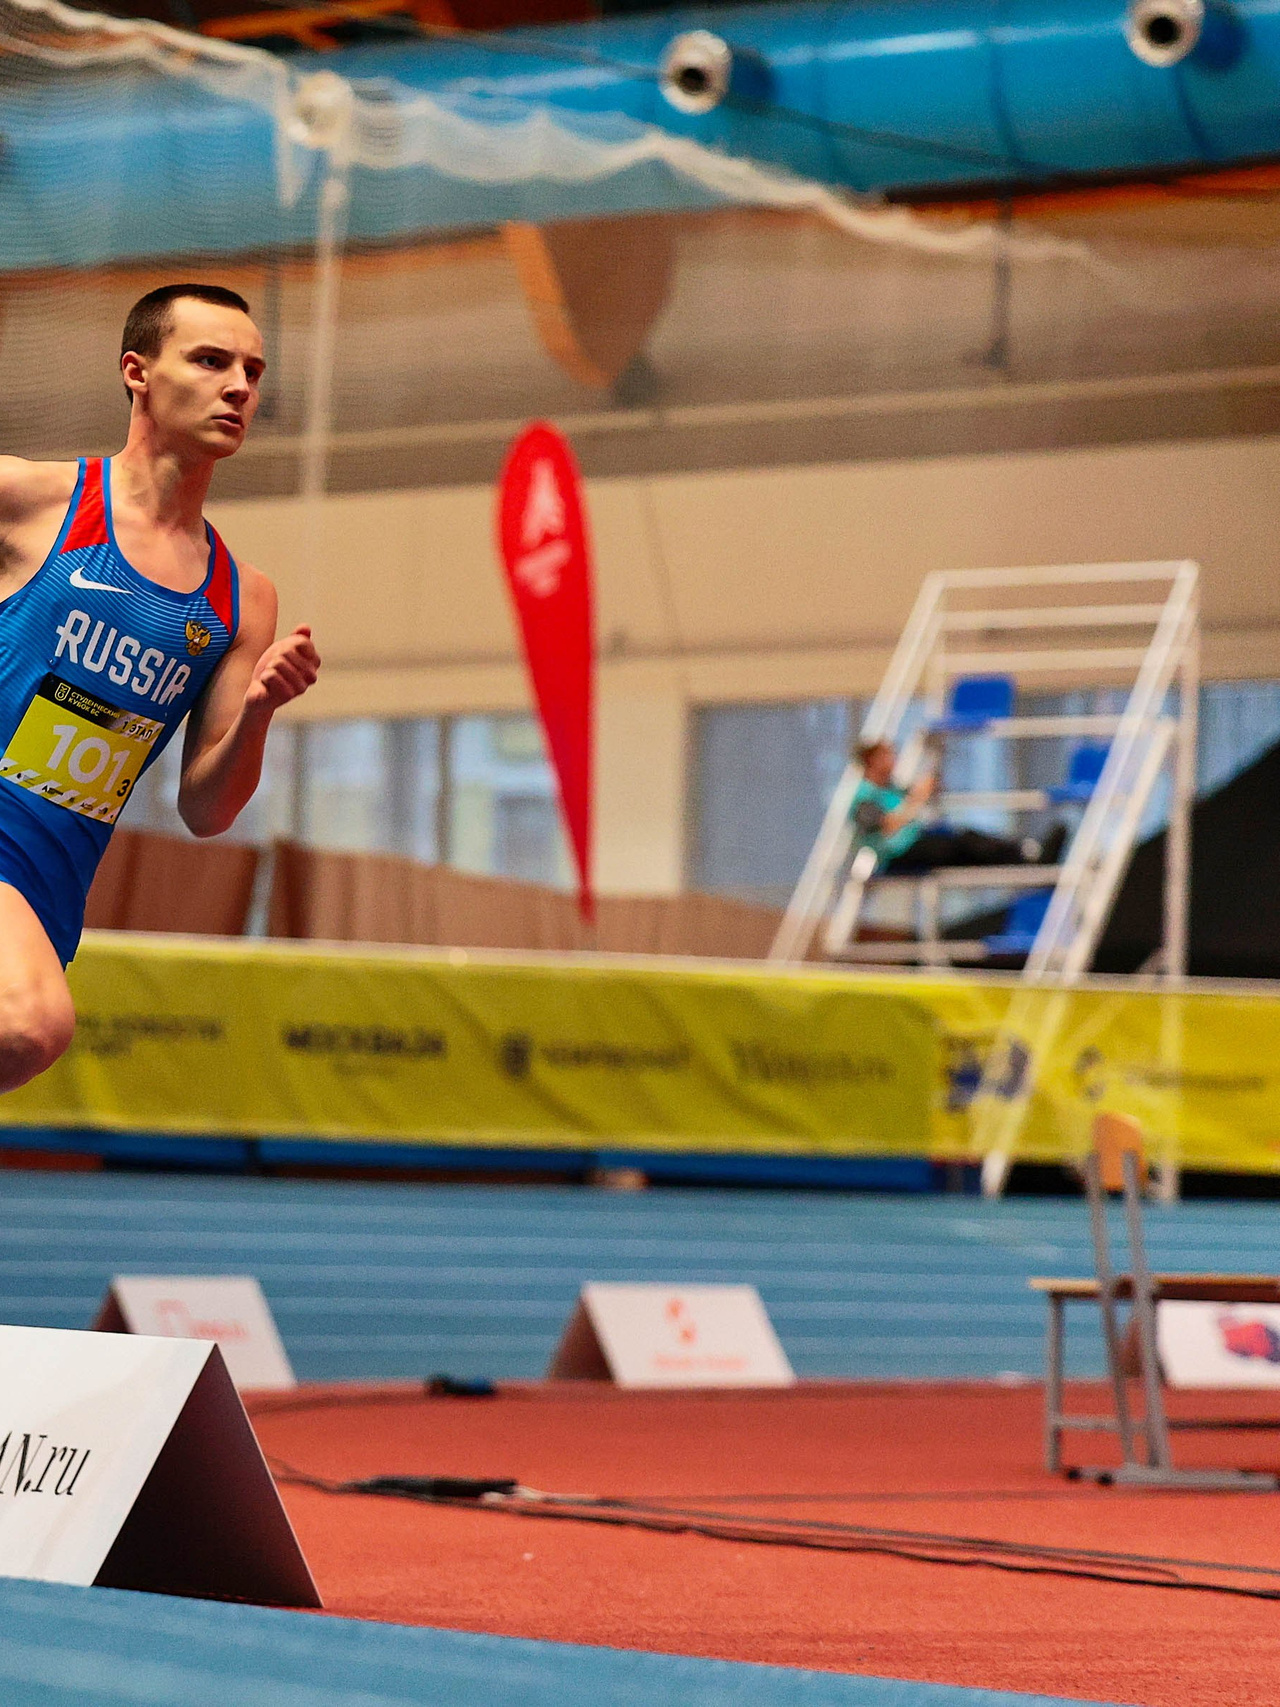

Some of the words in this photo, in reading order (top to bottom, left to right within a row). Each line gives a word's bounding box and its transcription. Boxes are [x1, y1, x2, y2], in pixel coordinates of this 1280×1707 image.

[54, 609, 191, 706] RUSSIA
[67, 697, 91, 713] КУБОК
[122, 721, 129, 730] 1
[129, 724, 153, 739] ЭТАП
[46, 725, 131, 793] 101
[116, 778, 131, 797] 3
